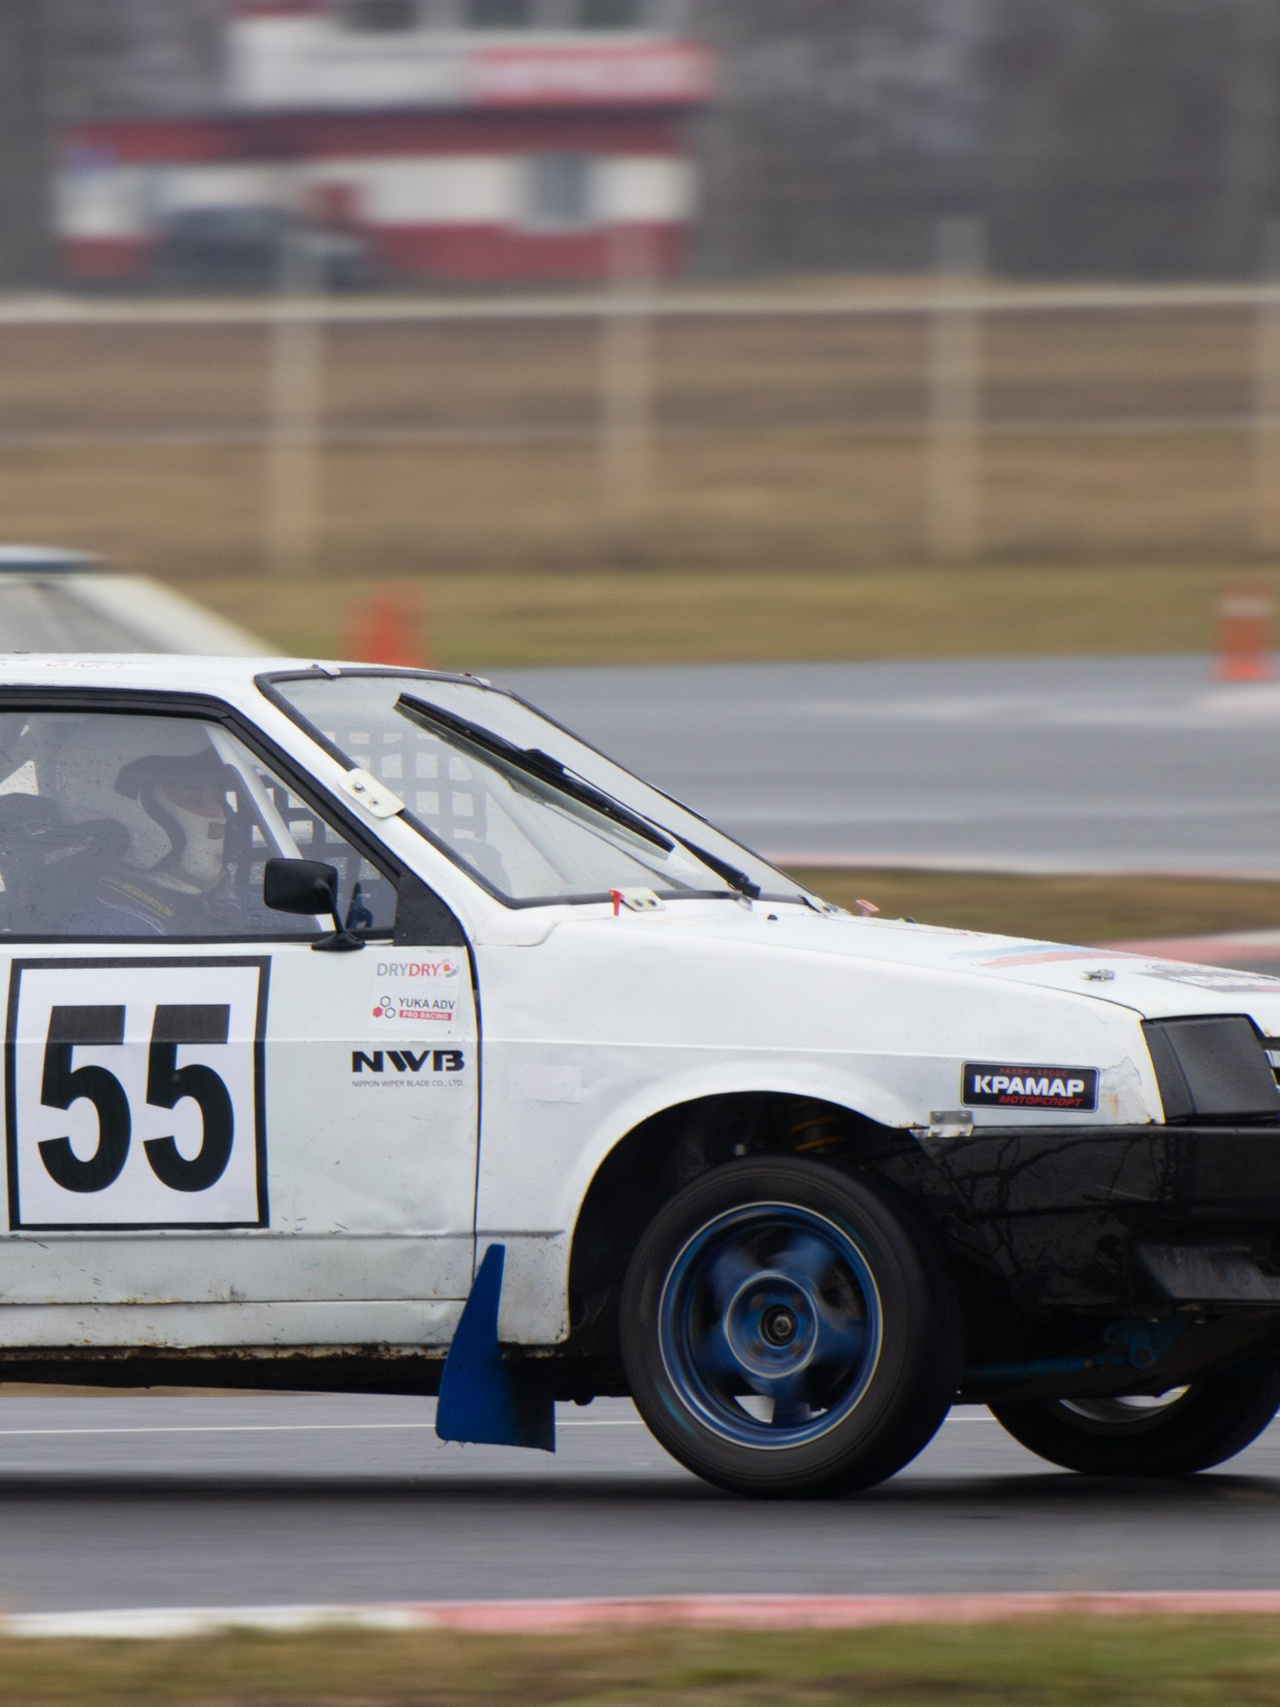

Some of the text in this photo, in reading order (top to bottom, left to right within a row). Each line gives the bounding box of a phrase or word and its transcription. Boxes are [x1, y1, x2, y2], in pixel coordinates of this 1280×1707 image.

[376, 963, 440, 977] DRYDRY
[398, 997, 456, 1010] YUKA ADV
[420, 1012, 449, 1020] RACING
[352, 1050, 465, 1073] NWB
[974, 1075, 1085, 1097] КРАМАР
[37, 1003, 236, 1194] 55
[999, 1096, 1083, 1106] МОТОРСПОРТ
